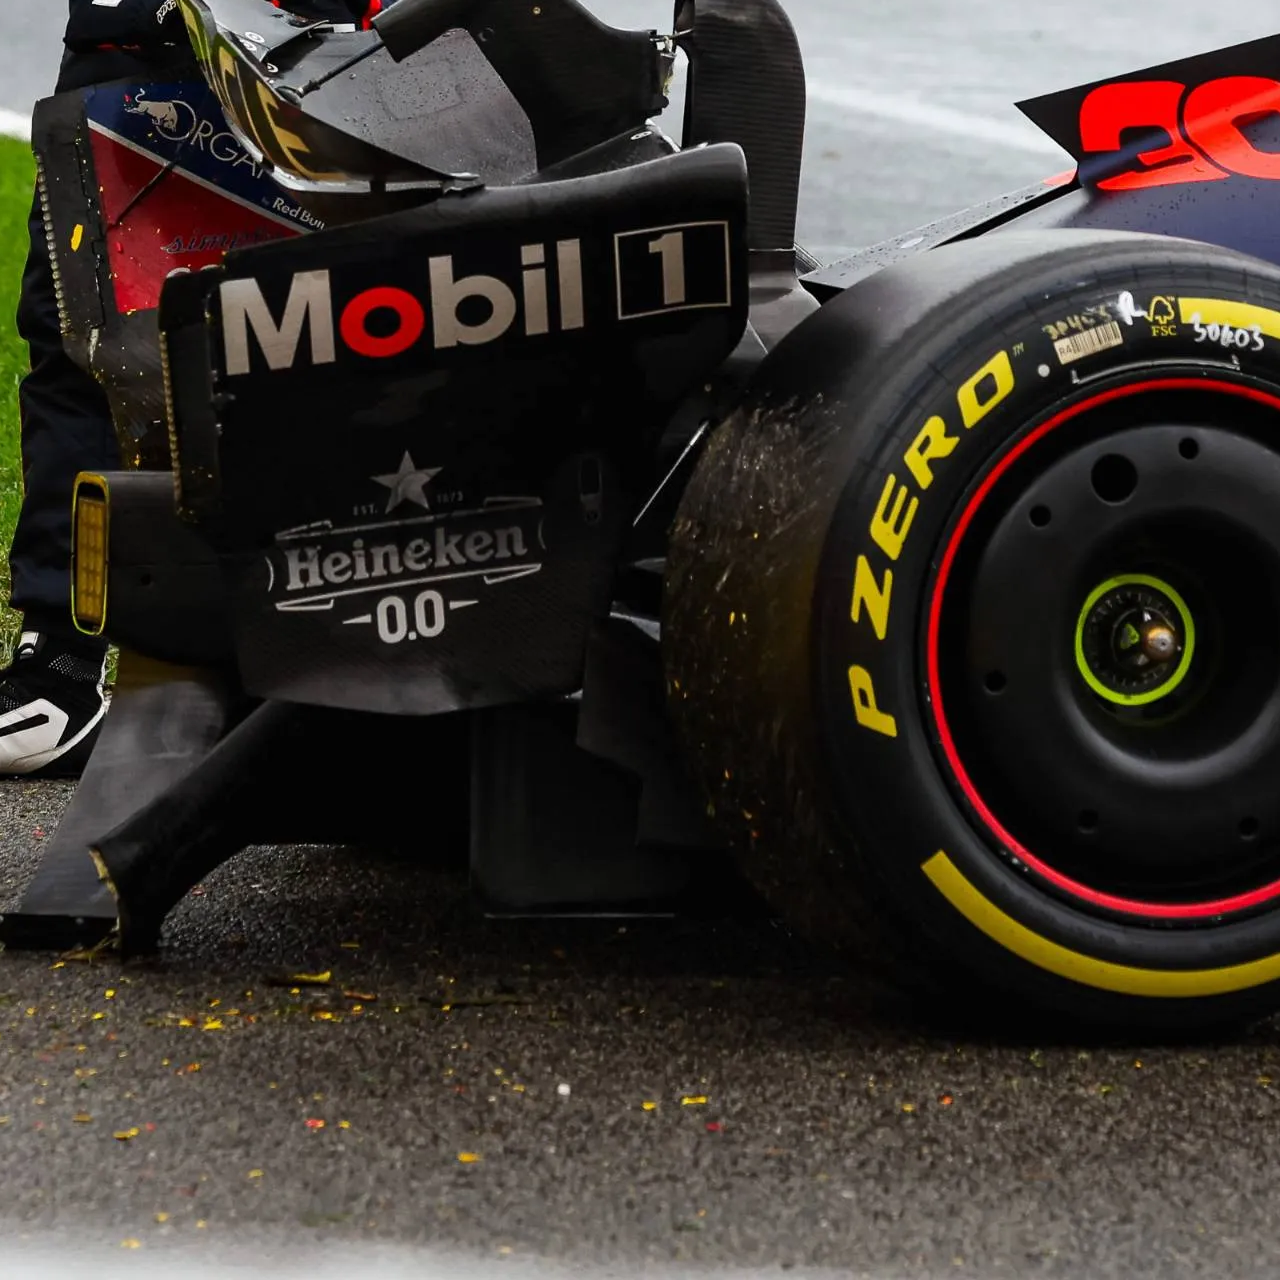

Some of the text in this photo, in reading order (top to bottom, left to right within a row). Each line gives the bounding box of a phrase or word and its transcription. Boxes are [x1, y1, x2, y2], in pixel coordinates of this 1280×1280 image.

[220, 231, 687, 376] Mobil 1
[1151, 325, 1178, 337] FSC
[851, 350, 1016, 640] ZERO
[285, 525, 528, 591] Heineken
[376, 590, 446, 644] 0.0
